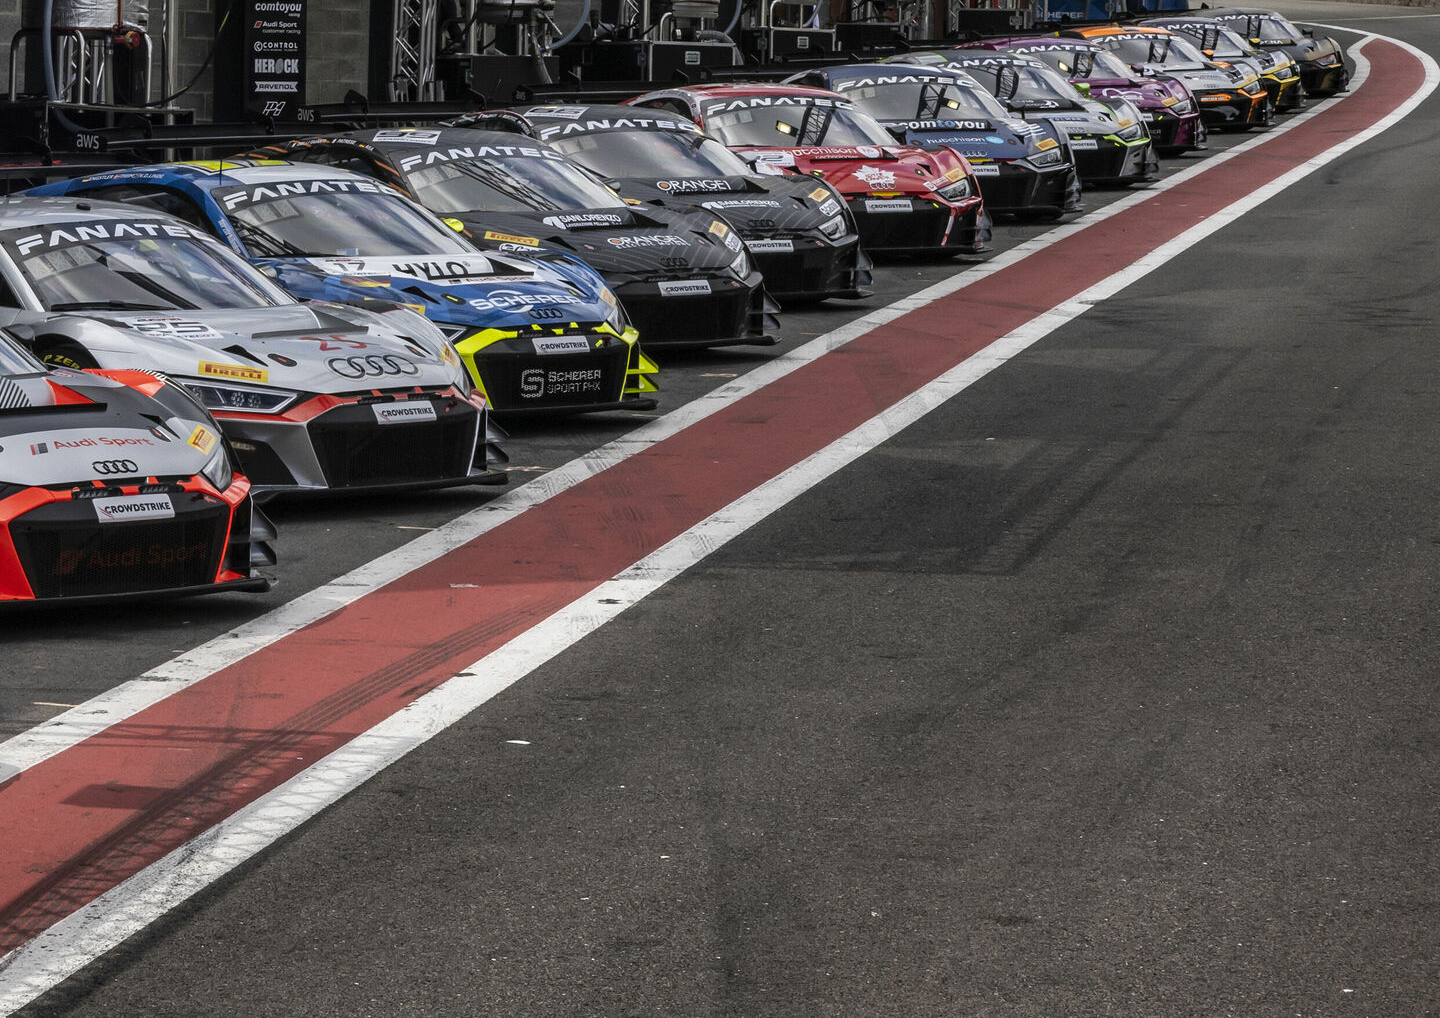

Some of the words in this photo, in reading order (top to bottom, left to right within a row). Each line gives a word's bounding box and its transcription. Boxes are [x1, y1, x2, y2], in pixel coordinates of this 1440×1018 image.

[255, 1, 302, 14] comtoyou
[279, 21, 298, 29] Sport
[254, 58, 299, 74] HEROCK
[937, 58, 1044, 70] ANATEC
[837, 75, 974, 93] FANATEC
[707, 96, 853, 116] FANATEC
[298, 109, 315, 122] aws
[540, 119, 699, 141] FANATEC
[76, 133, 100, 150] aws
[401, 145, 565, 172] FANATEC
[656, 179, 732, 192] ORANGE1
[223, 180, 396, 211] FANATEC
[560, 213, 622, 224] SANLORENZO
[16, 218, 215, 256] FANATEC
[490, 232, 535, 245] PIRELLI
[664, 285, 710, 293] CROWDSTRIKE
[298, 334, 367, 352] 25
[540, 341, 590, 352] CROWDSTRIKE
[54, 354, 81, 370] ZER
[204, 363, 262, 380] PIRELLI
[548, 369, 601, 383] SCHERER
[382, 404, 433, 419] CROWDSTRIKE
[53, 437, 94, 450] Audi
[99, 435, 154, 450] Sport
[105, 501, 171, 516] CROWDSTRIKE
